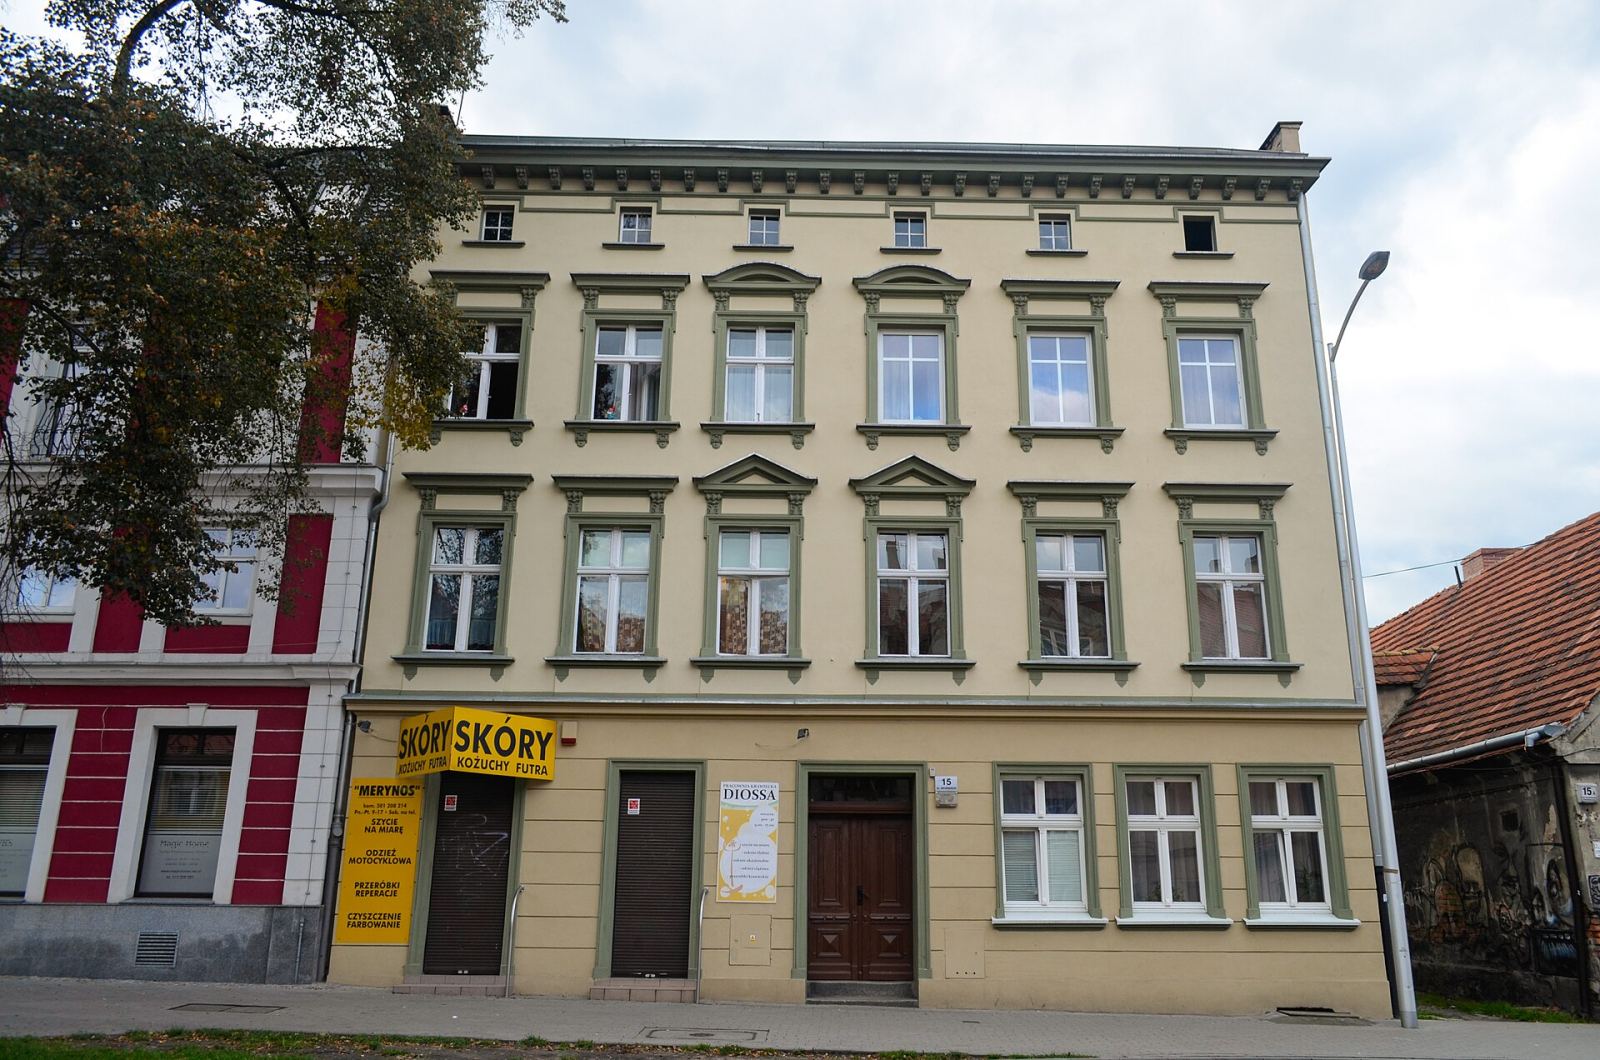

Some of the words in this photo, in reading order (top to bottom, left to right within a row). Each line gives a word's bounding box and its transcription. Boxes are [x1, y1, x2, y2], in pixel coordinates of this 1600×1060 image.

[399, 715, 452, 759] SKÓRY
[454, 716, 553, 761] SKÓRY
[399, 759, 426, 775] KOŻUCHY
[428, 756, 447, 769] FUTRA
[457, 756, 510, 771] KOŻUCHY
[516, 763, 548, 776] FUTRA
[724, 788, 776, 801] DIOSSA
[1582, 787, 1592, 796] 15
[371, 818, 399, 826] SZYCIE
[378, 826, 404, 834] MIARĘ
[365, 848, 397, 857] ODZIEŻ
[348, 857, 412, 865] MOTOCYKLOWA
[354, 880, 400, 889] PRZERÓBKI
[355, 889, 398, 897] REPERACJE
[347, 912, 402, 920] CZYSZCZENIE
[346, 921, 401, 929] FARBOWANIE
